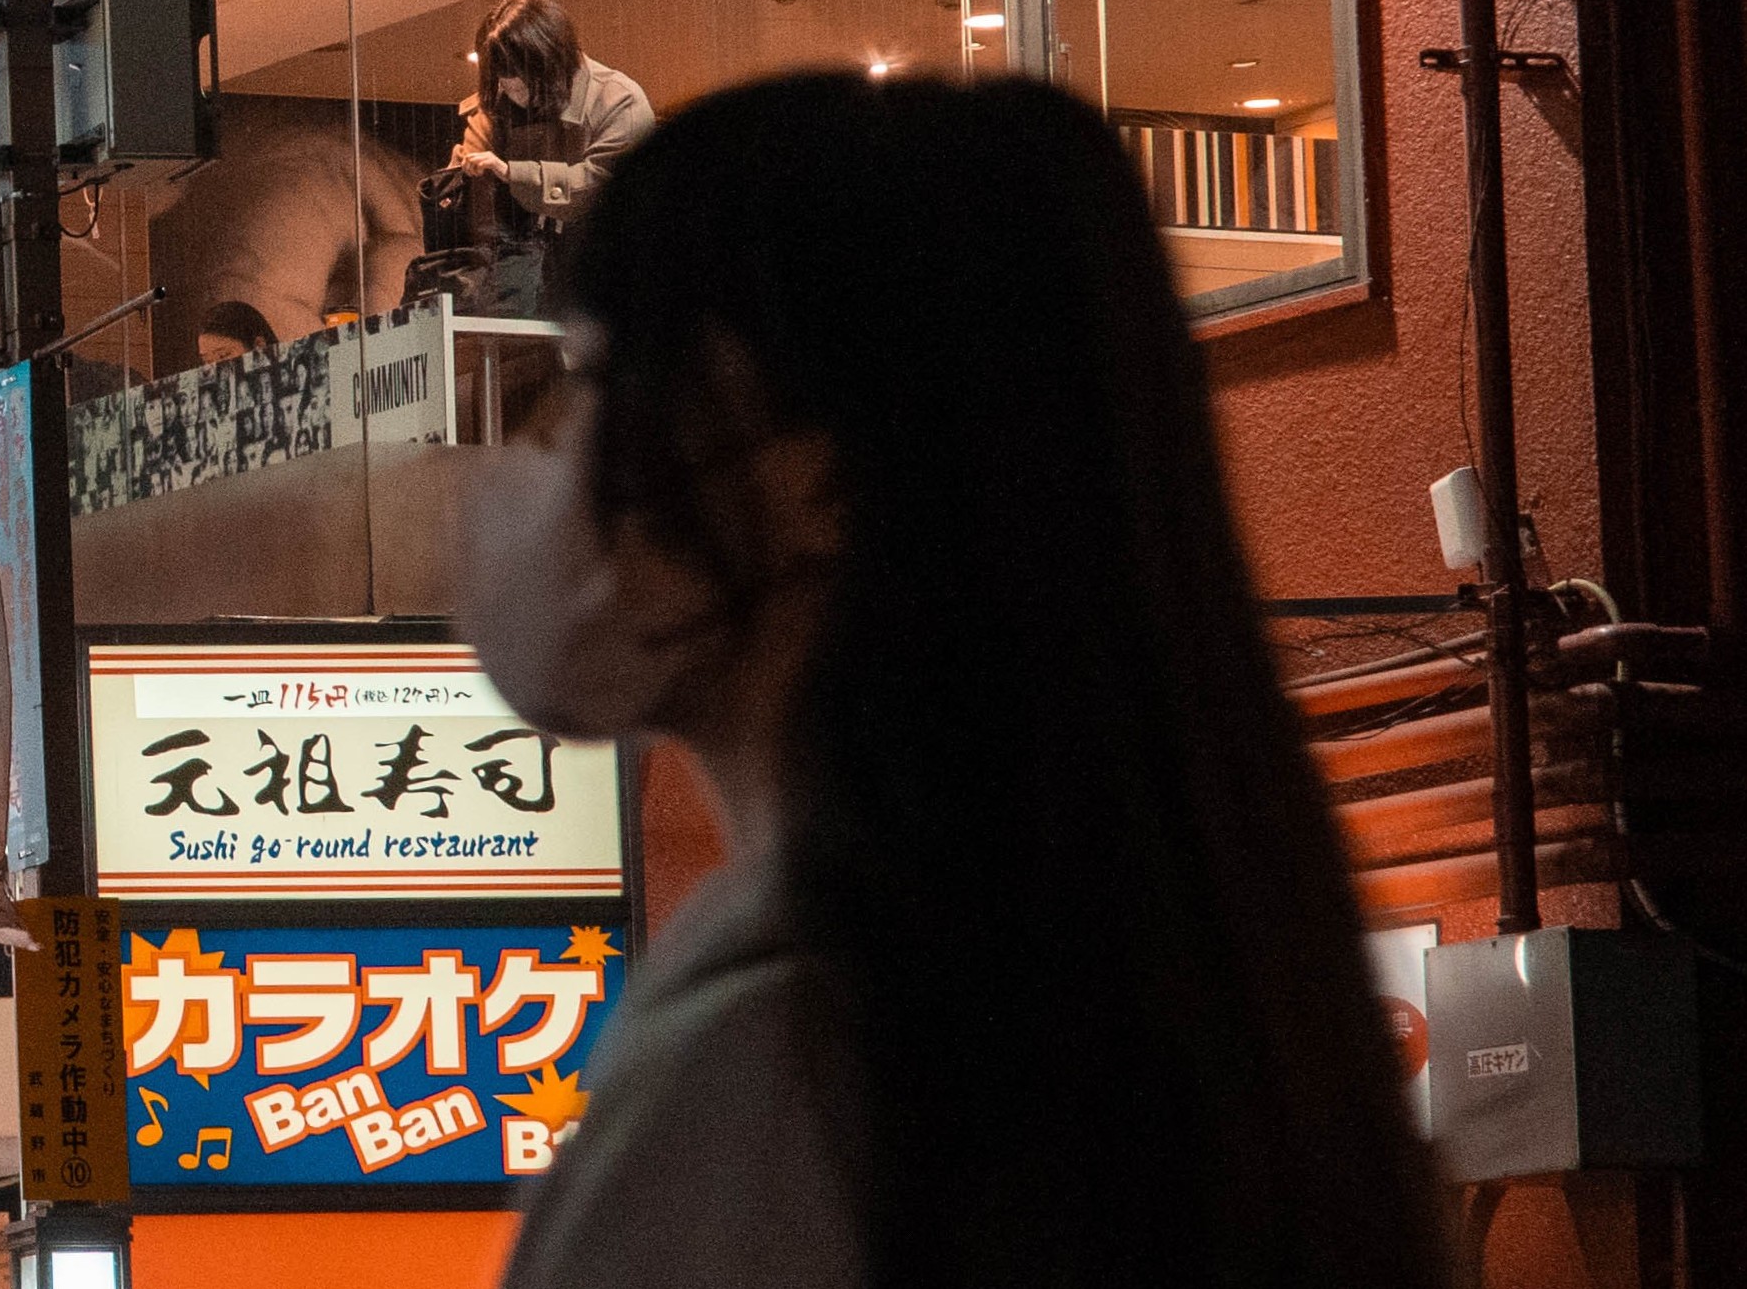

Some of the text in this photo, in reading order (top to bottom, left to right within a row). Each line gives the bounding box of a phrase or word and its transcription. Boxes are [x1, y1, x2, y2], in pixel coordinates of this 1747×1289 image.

[352, 351, 429, 419] COMMUNITY
[142, 722, 562, 821] 元祖寿司
[168, 827, 541, 865] Sushi go-round restaurant
[126, 948, 604, 1077] カラオケ
[27, 1069, 47, 1185] 武蔵野市
[247, 1067, 384, 1156] Ban
[345, 1083, 485, 1176] Ban
